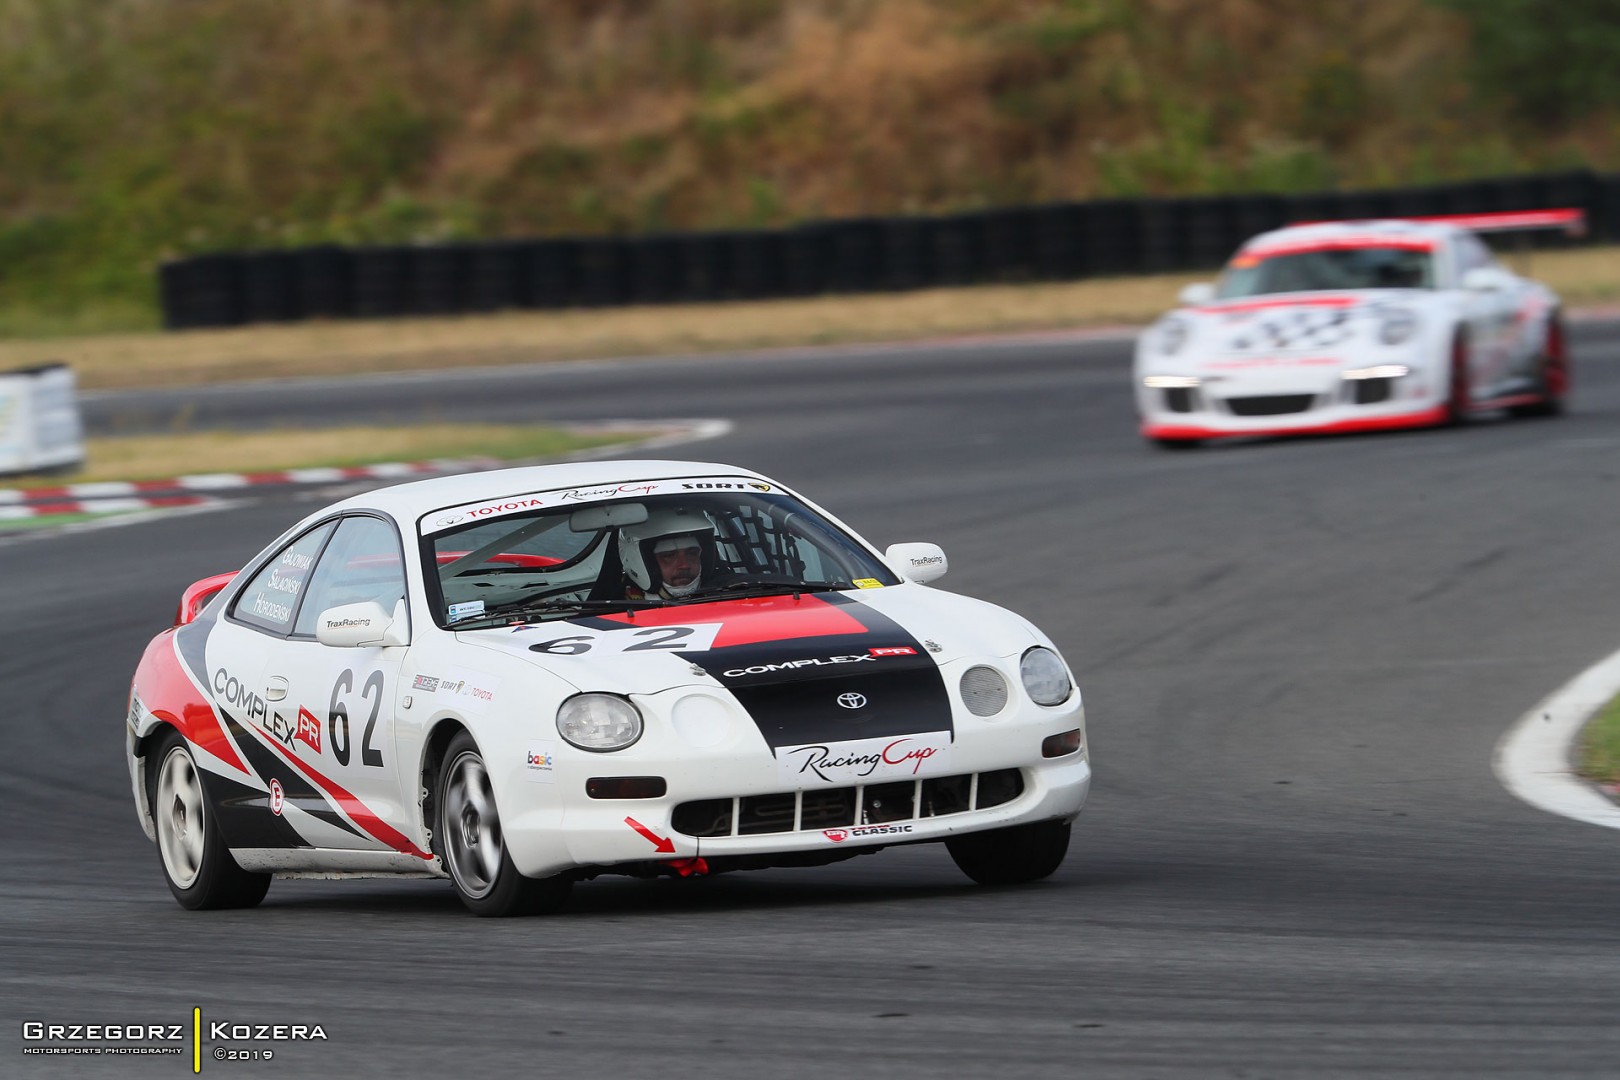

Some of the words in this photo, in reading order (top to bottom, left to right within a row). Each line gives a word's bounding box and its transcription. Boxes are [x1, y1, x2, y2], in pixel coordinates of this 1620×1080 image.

[466, 498, 543, 518] TOYOTA
[681, 482, 746, 490] SORT
[910, 555, 942, 566] TraxRacing
[326, 618, 371, 628] TraxRacing
[471, 687, 493, 701] TOYOTA
[328, 668, 384, 768] 62
[527, 750, 552, 766] basic
[852, 825, 913, 837] CLASSIC
